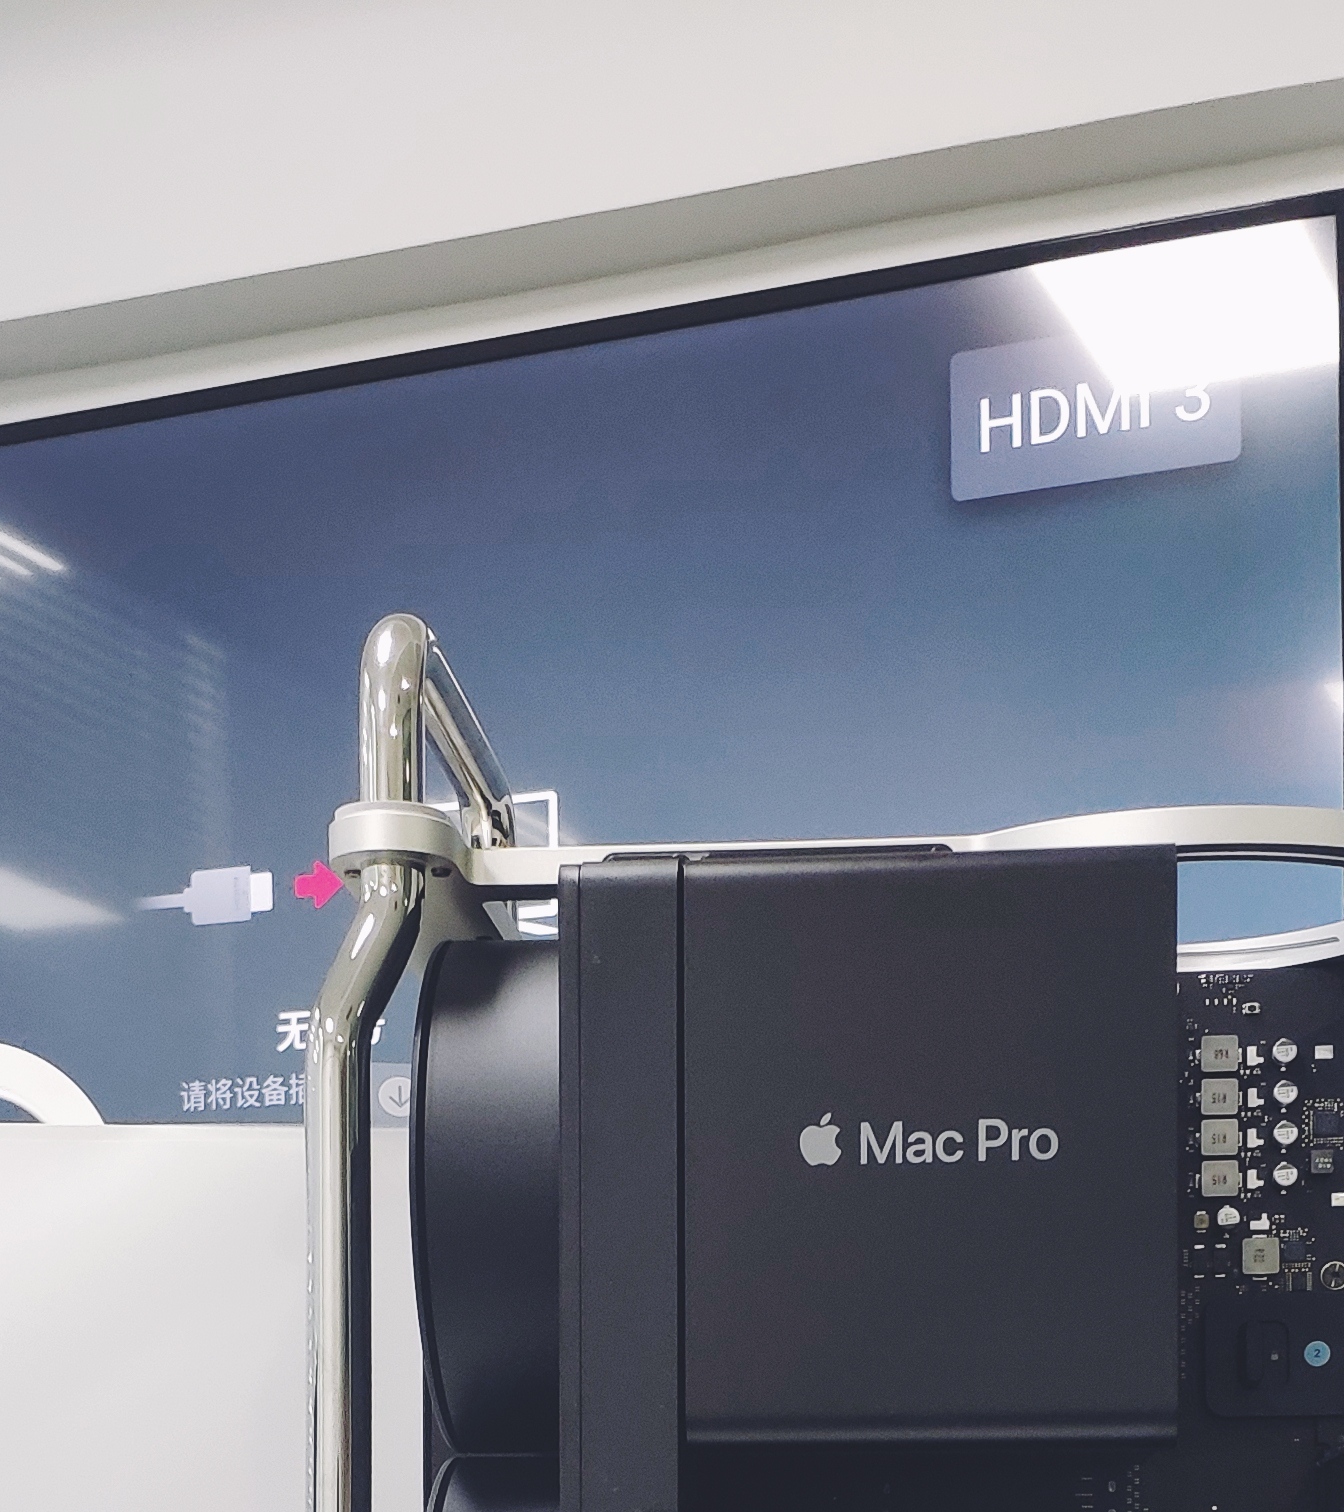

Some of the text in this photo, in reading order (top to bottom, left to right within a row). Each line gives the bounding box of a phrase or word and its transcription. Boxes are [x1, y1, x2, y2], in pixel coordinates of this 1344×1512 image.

[979, 381, 1212, 454] HDMI 3
[859, 1117, 1060, 1165] Mac Pro
[1314, 1348, 1321, 1358] 2
